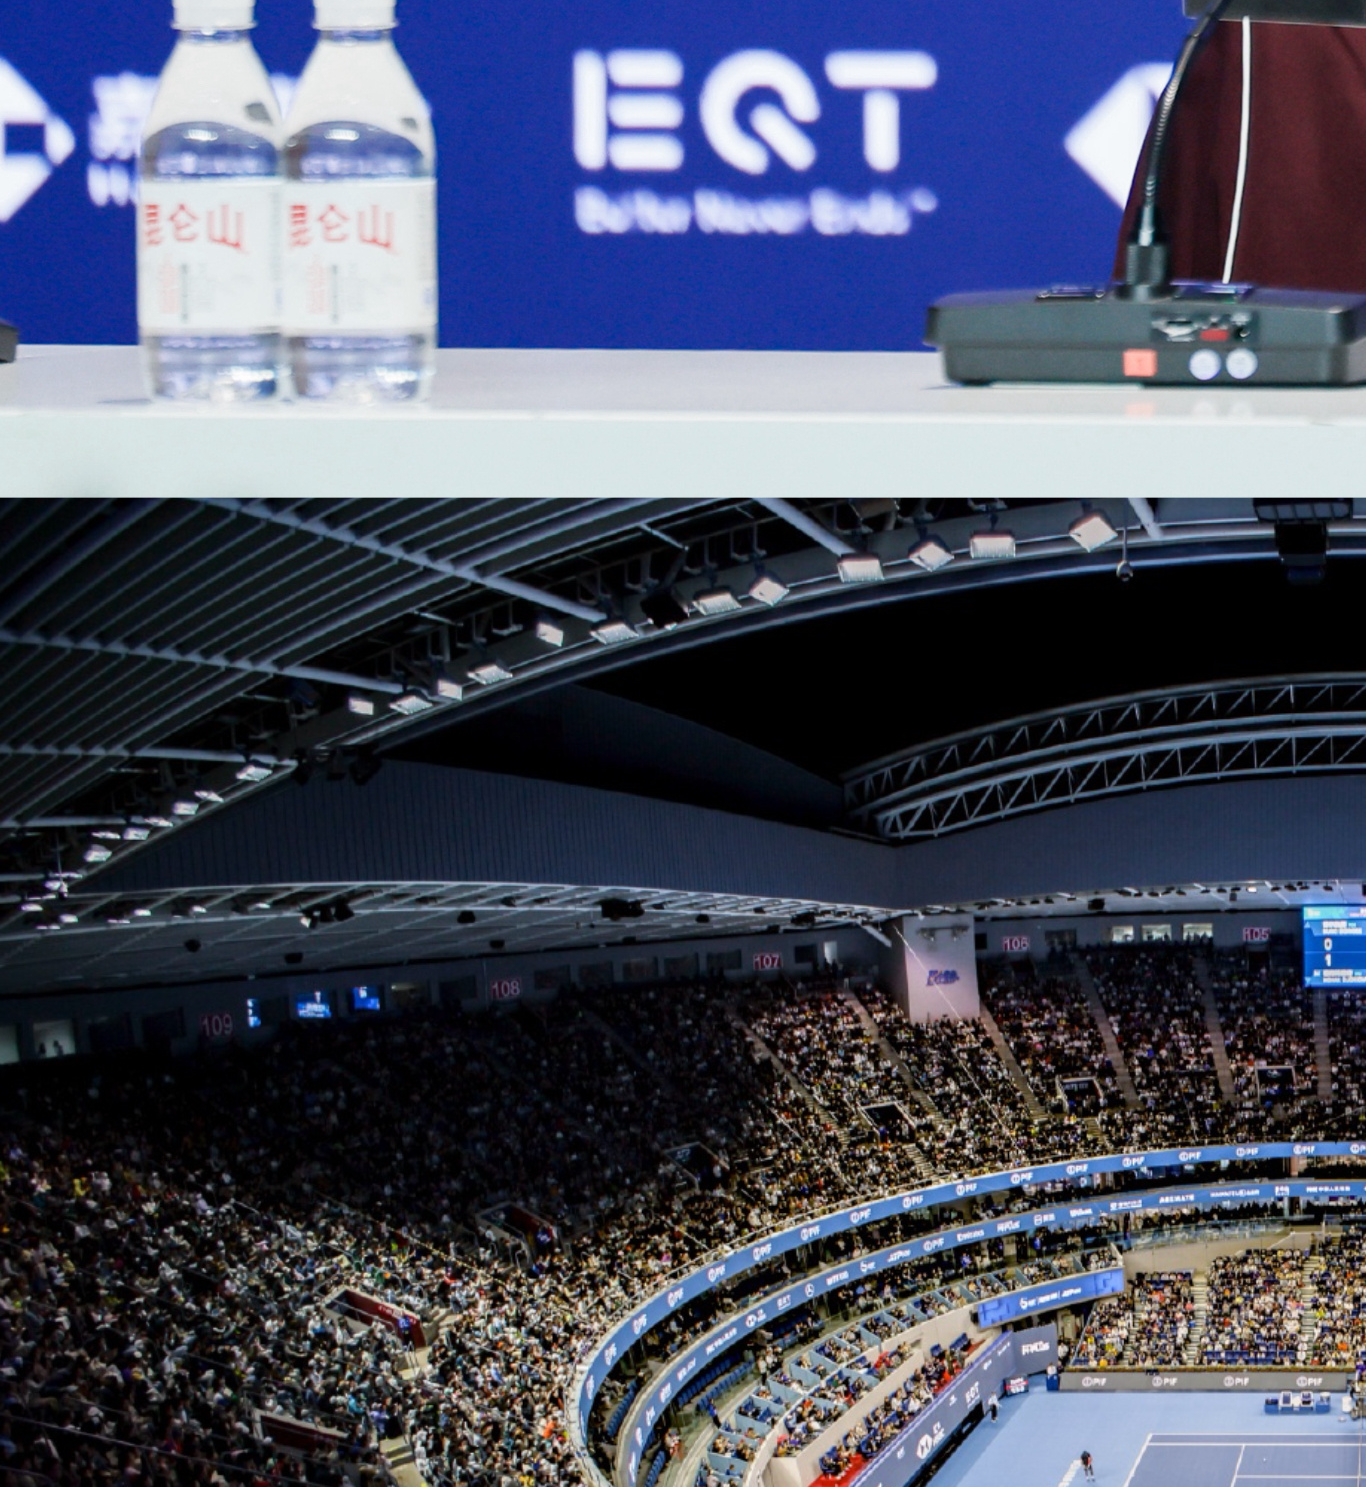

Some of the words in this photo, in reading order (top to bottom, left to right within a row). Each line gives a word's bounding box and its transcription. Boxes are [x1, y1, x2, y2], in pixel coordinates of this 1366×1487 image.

[574, 50, 937, 175] EQT
[1324, 937, 1333, 951] 0
[754, 954, 781, 969] 107
[1325, 953, 1332, 967] 1
[492, 980, 521, 997] 108
[201, 1015, 233, 1037] 109
[1093, 1378, 1107, 1387] PIF
[1163, 1378, 1178, 1387] PIF
[1234, 1377, 1250, 1387] PIF
[1308, 1377, 1323, 1387] PIF
